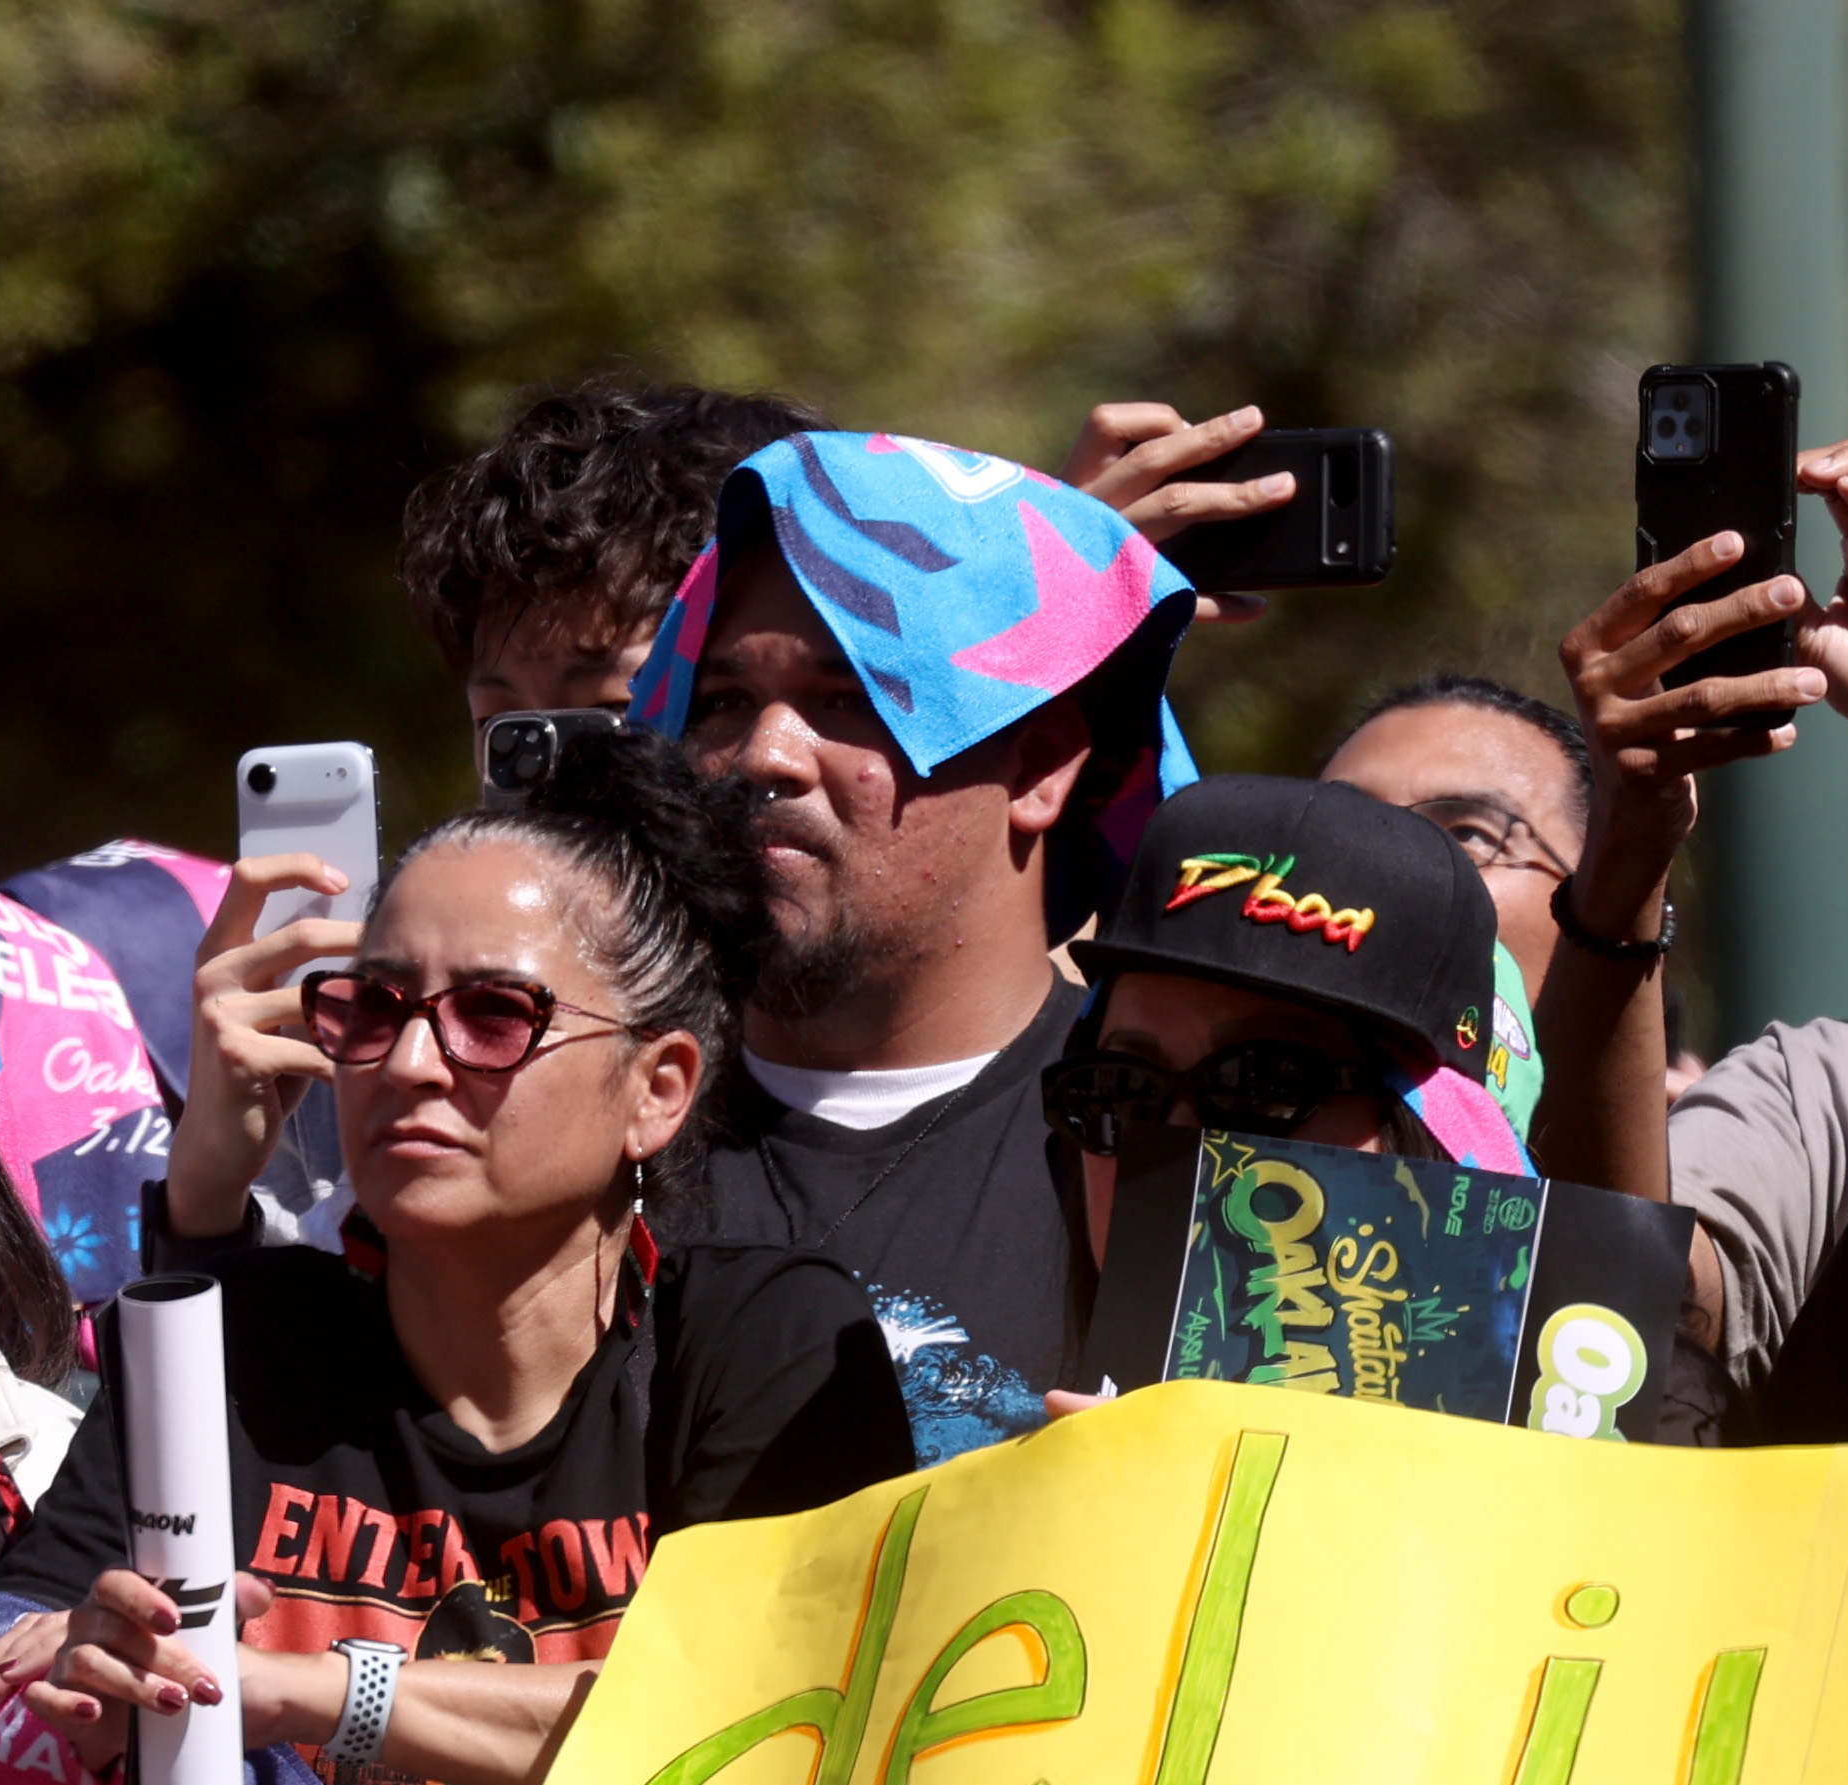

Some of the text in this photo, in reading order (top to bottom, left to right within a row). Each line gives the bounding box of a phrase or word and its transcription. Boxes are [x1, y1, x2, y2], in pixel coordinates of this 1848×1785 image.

[42, 1037, 159, 1101] Oak
[75, 1106, 174, 1157] 3.12
[1444, 1174, 1471, 1237] ROVE
[1327, 1235, 1408, 1407] Shoutou
[501, 1511, 652, 1623] TOW
